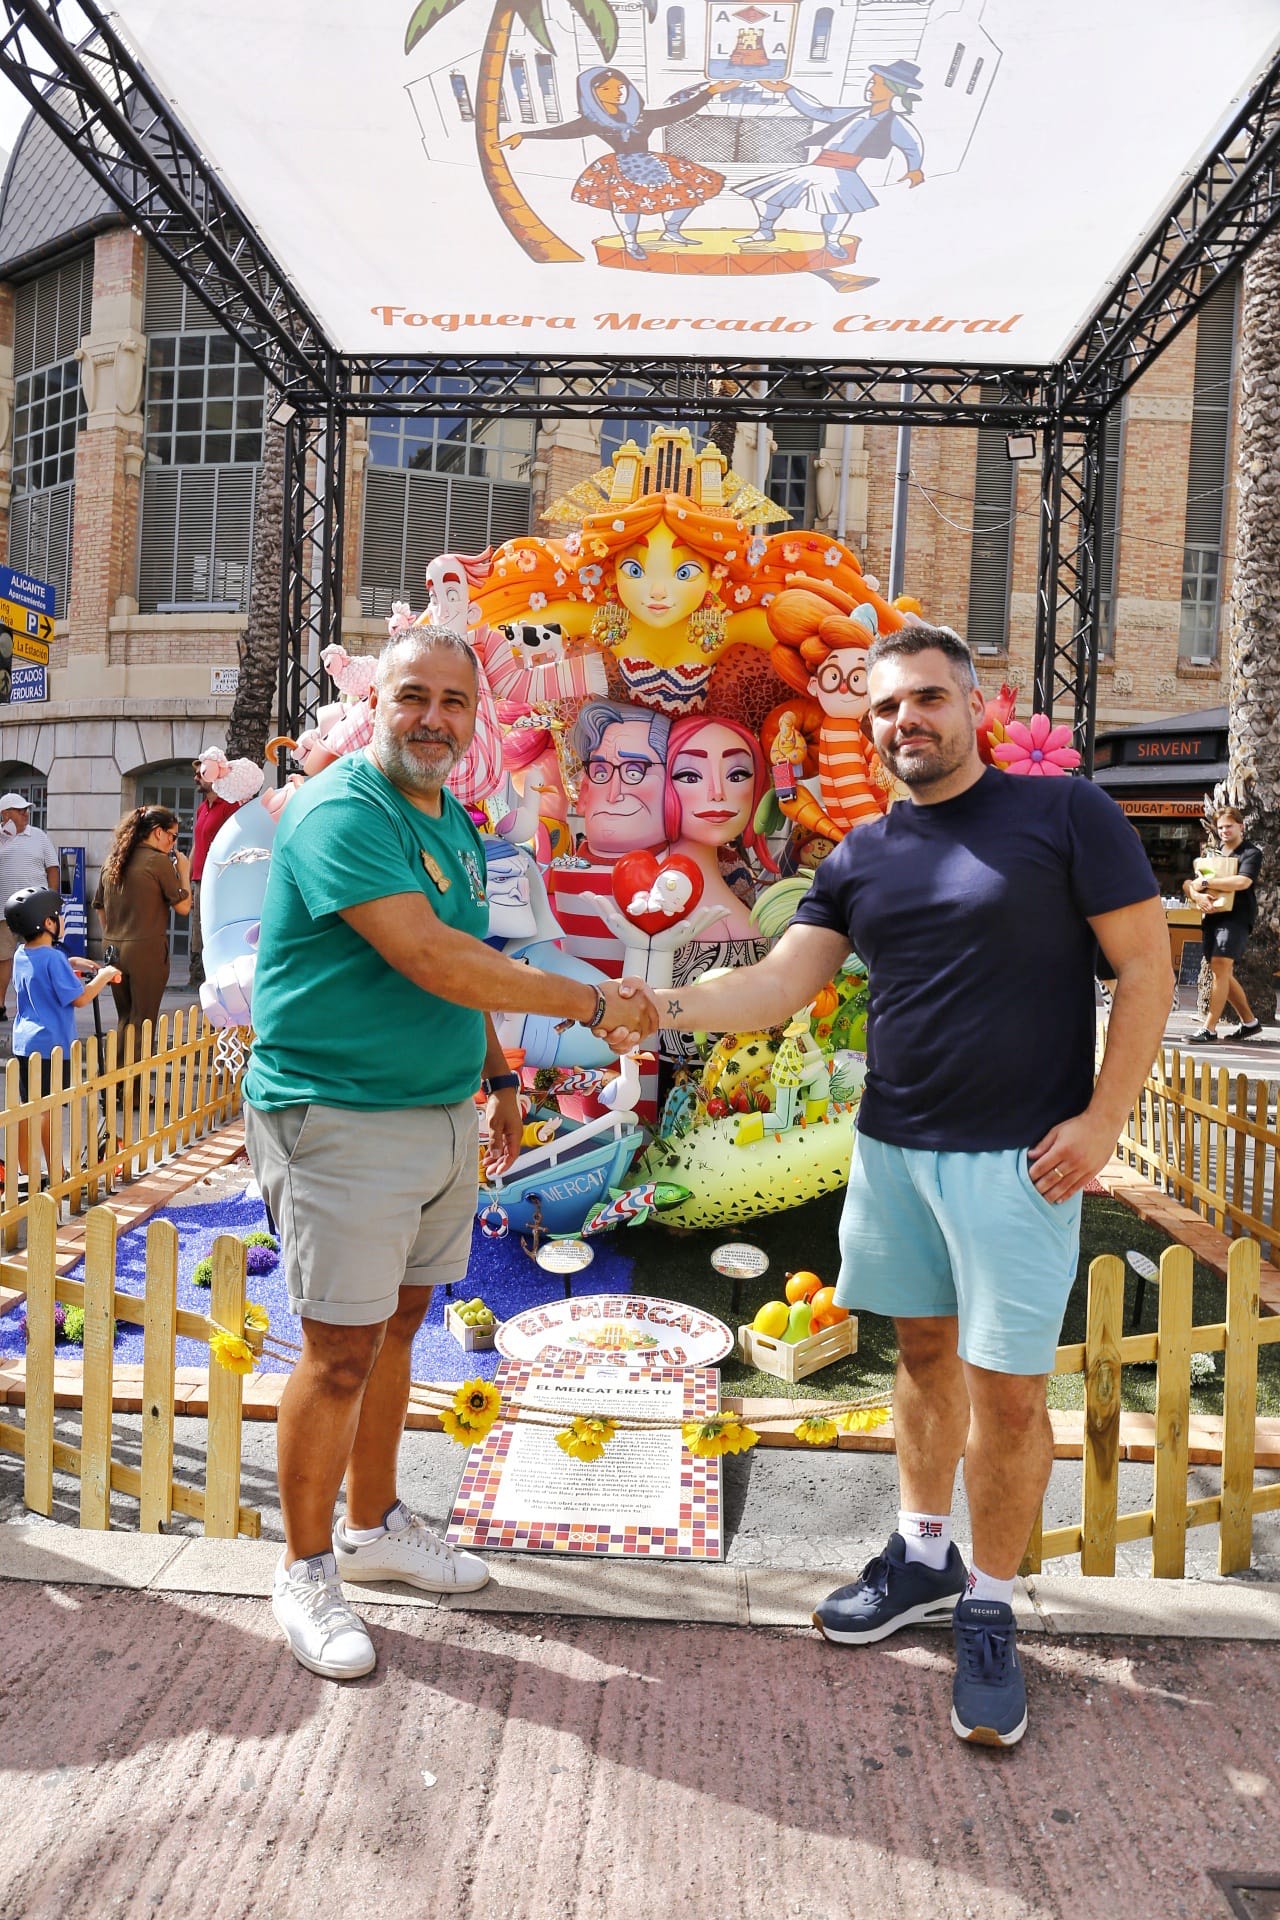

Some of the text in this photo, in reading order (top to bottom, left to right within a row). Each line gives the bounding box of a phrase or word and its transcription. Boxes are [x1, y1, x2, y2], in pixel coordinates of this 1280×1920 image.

[716, 10, 786, 22] A L
[718, 42, 786, 54] L A
[370, 306, 1024, 333] Foguera Mercado Central
[10, 575, 46, 598] ALICANTE
[8, 588, 46, 610] Aparcamientos
[17, 640, 47, 660] La Estación
[12, 668, 43, 685] ESCADOS
[1137, 741, 1201, 758] SIRVENT
[540, 1166, 606, 1202] MERCAT
[516, 1300, 717, 1338] EL MERCAT
[535, 1345, 688, 1367] ERES TU
[555, 1386, 611, 1394] MERCAT
